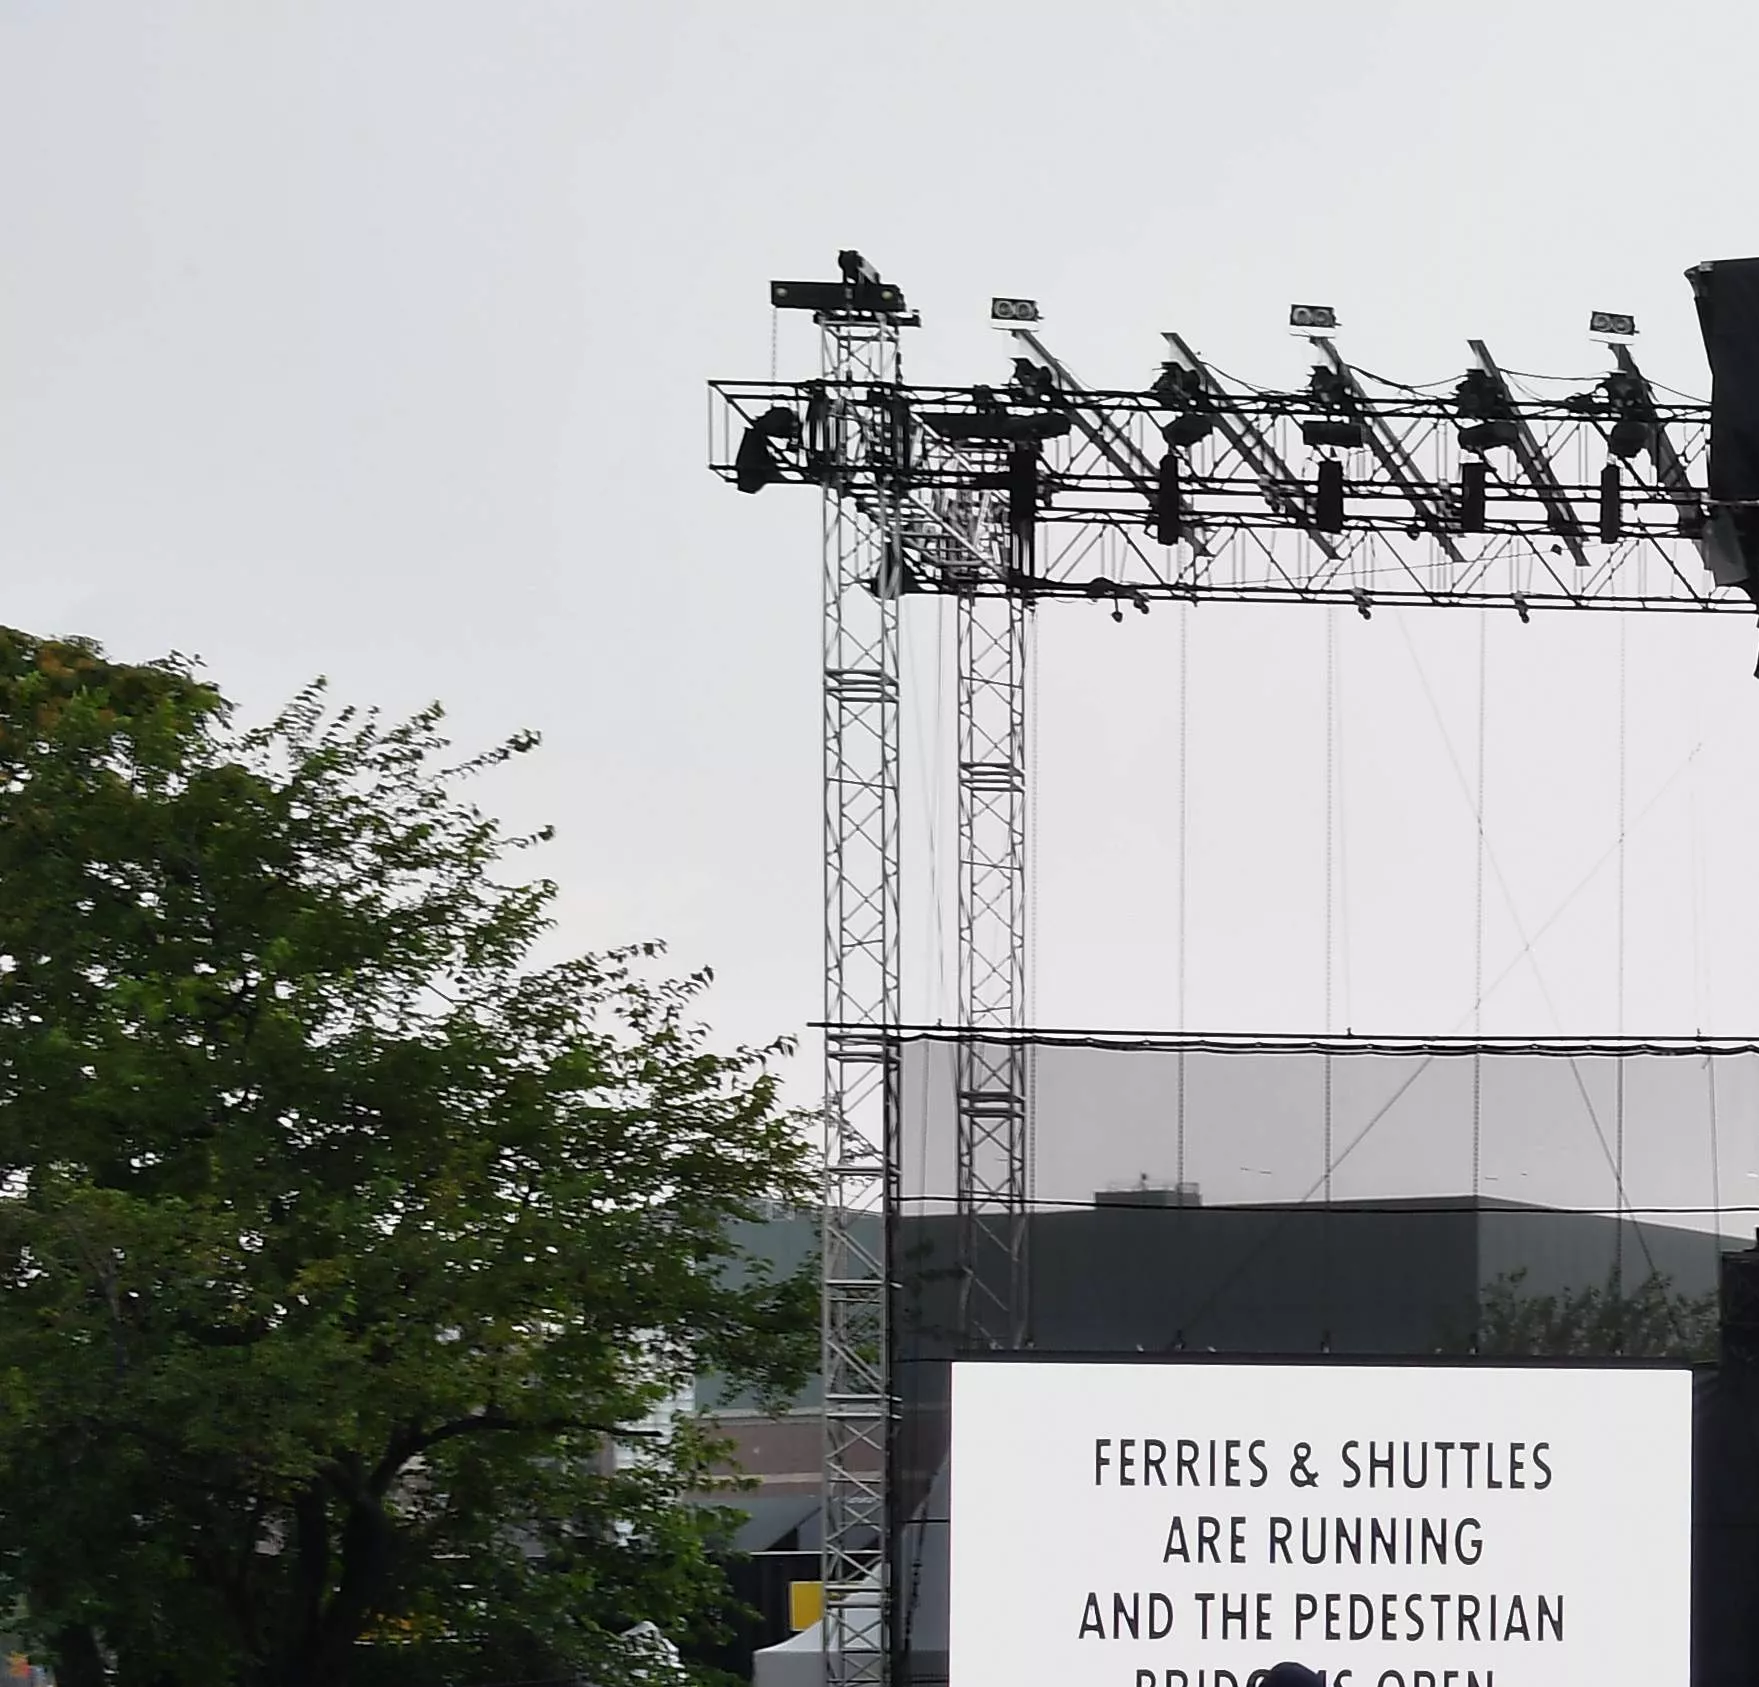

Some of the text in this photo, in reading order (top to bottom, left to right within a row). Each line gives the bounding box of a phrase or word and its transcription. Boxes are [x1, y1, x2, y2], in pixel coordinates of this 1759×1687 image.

[1095, 1439, 1551, 1490] FERRIES & SHUTTLES
[1163, 1516, 1483, 1565] ARE RUNNING
[1078, 1592, 1563, 1641] AND THE PEDESTRIAN
